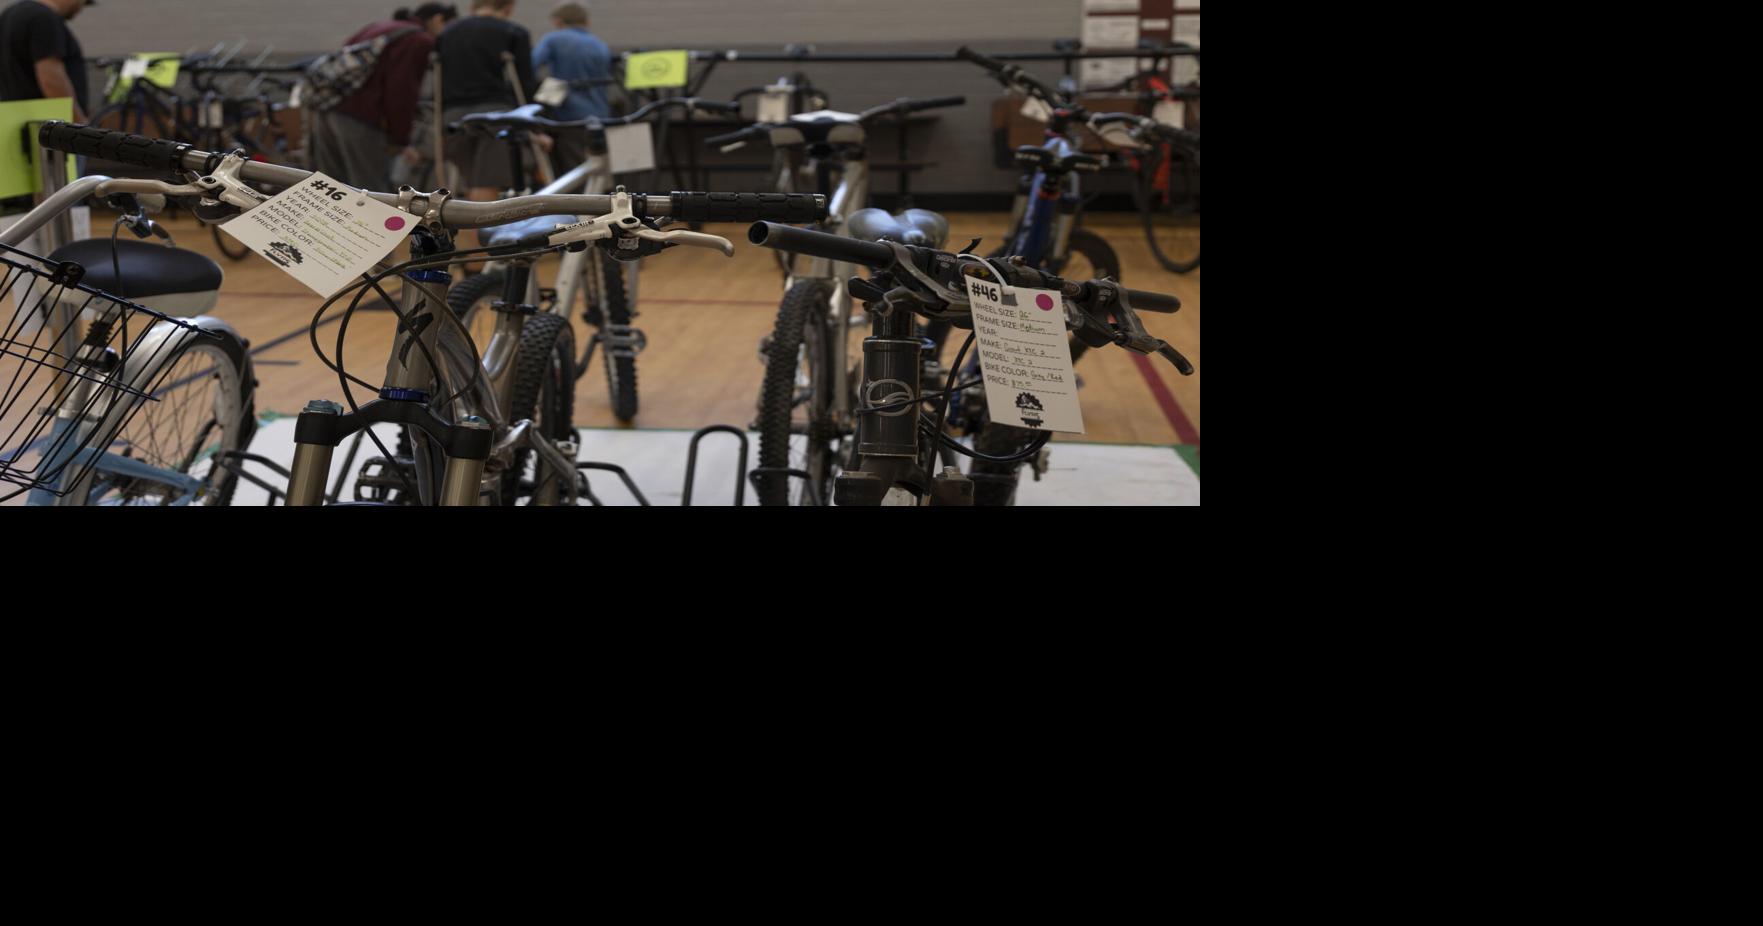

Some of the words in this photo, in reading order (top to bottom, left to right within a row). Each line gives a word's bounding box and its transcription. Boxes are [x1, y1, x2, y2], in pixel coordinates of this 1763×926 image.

[310, 180, 347, 201] #16
[286, 195, 310, 214] YEAR:
[293, 191, 324, 212] FRAME
[324, 211, 345, 225] SIZE:
[301, 186, 331, 207] WHEEL
[331, 205, 353, 219] SIZE:
[259, 210, 281, 225] BIKE
[971, 282, 998, 302] #46
[974, 302, 997, 315] WHEEL
[998, 307, 1016, 318] SIZE:
[976, 313, 1000, 327] FRAME
[985, 361, 1001, 373] BIKE
